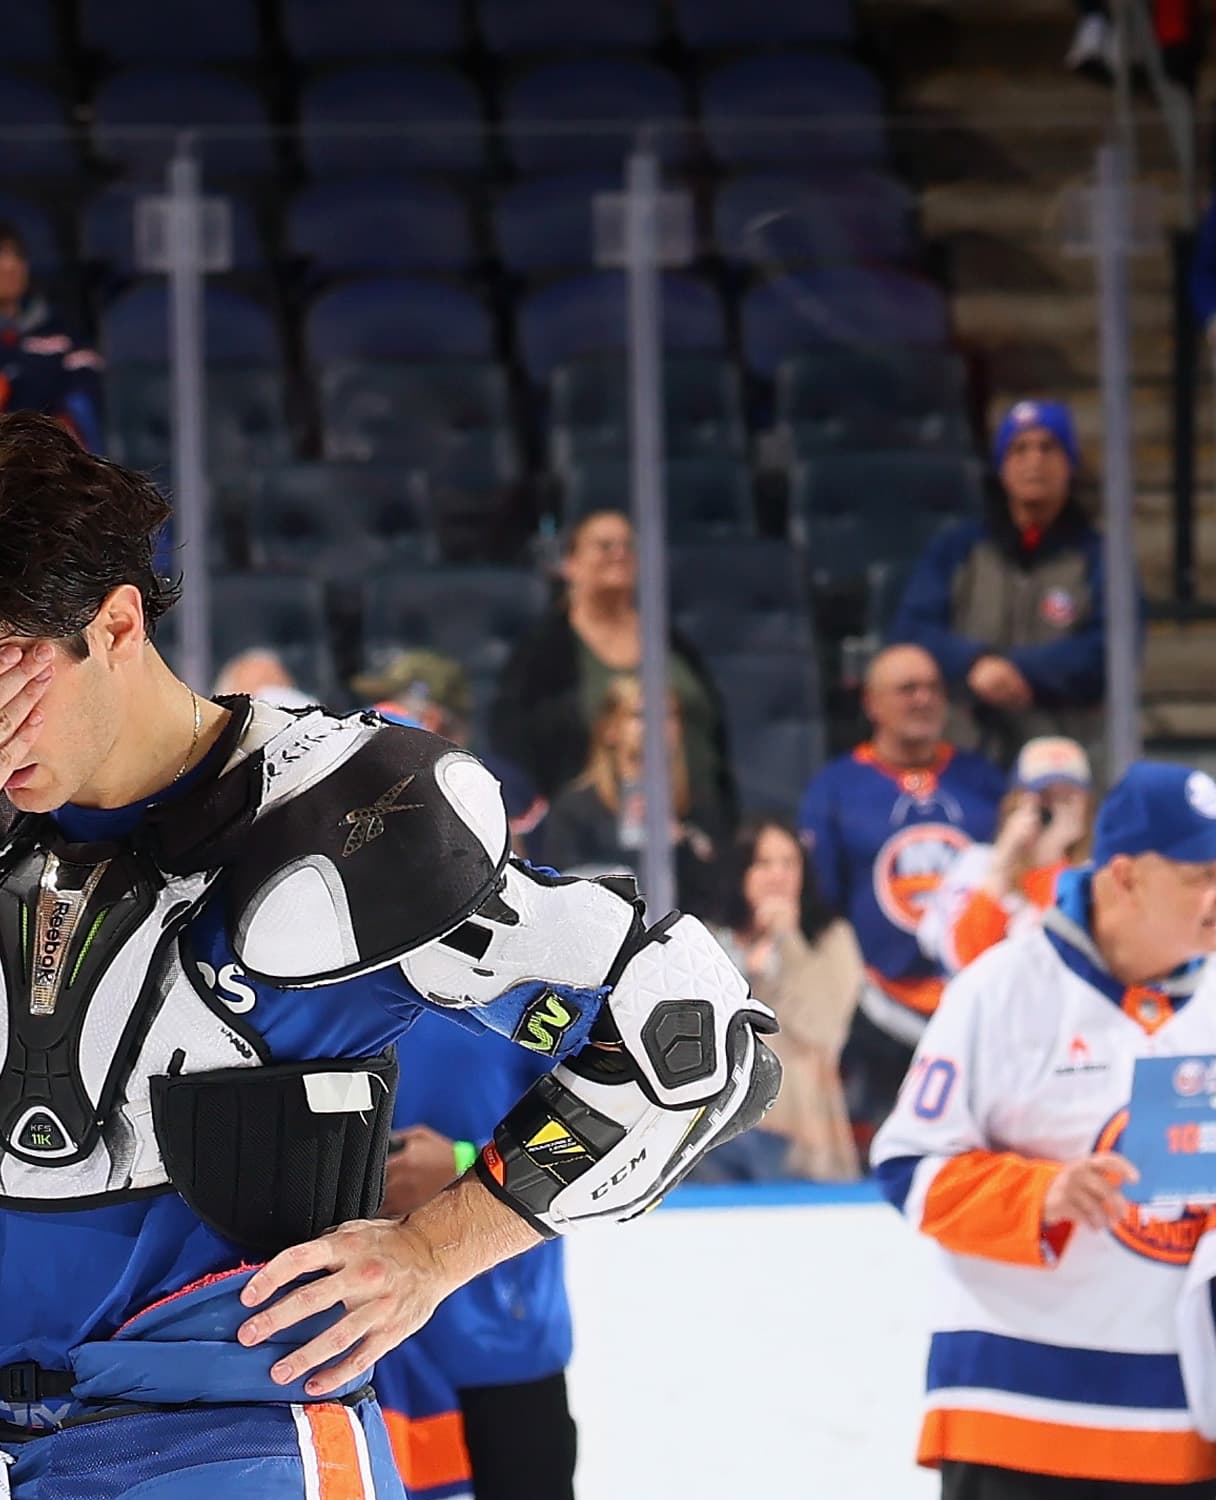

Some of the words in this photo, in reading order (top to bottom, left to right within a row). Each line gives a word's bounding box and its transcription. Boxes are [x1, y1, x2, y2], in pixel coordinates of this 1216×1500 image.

[36, 901, 70, 984] Reebok
[910, 1056, 957, 1119] 0
[30, 1123, 52, 1133] KFS
[31, 1132, 52, 1146] 11K
[591, 1148, 647, 1200] CCM
